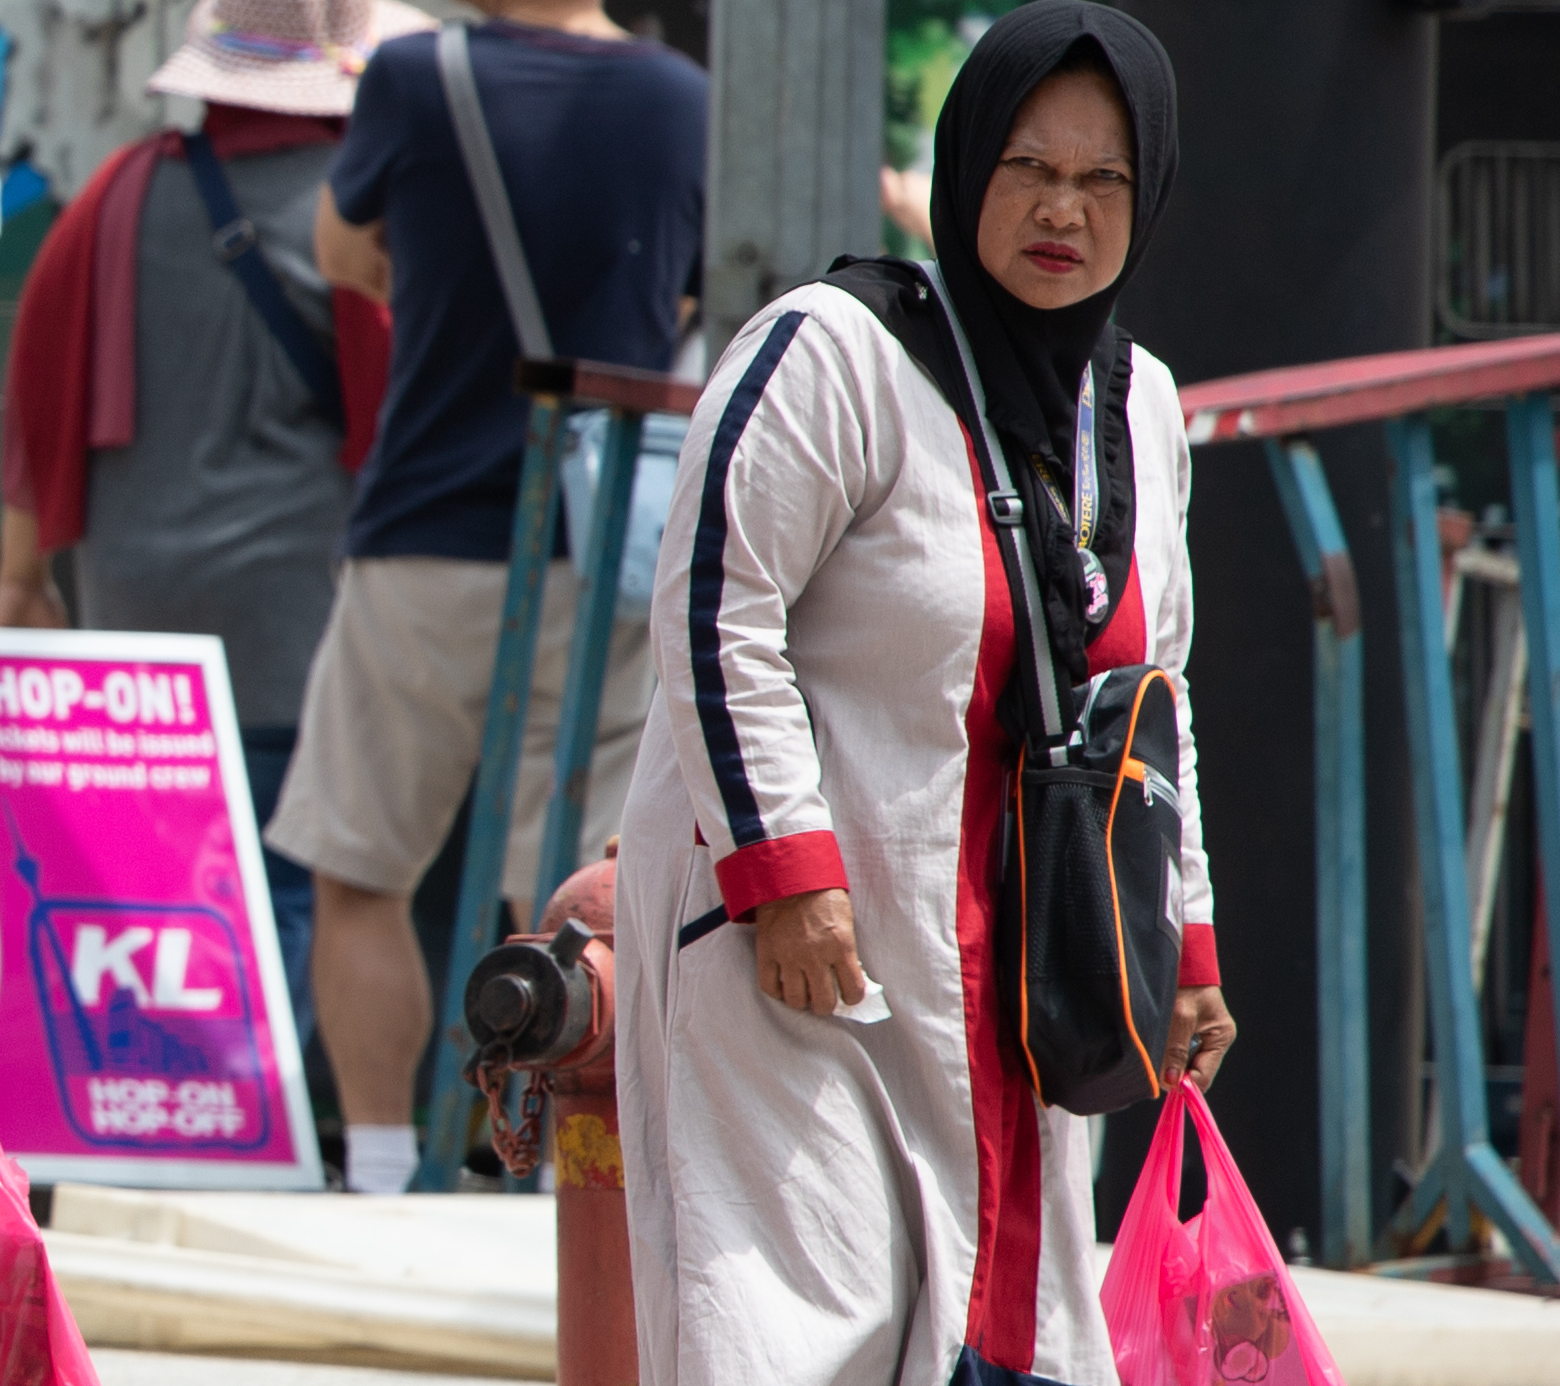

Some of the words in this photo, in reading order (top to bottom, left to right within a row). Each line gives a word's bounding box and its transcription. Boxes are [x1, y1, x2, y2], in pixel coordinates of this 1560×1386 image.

[62, 726, 104, 755] will
[105, 727, 135, 757] be
[138, 729, 216, 758] issued
[26, 762, 63, 787] our
[66, 761, 147, 792] ground
[149, 766, 211, 790] crew
[73, 924, 222, 1010] KL
[88, 1076, 235, 1106] HOP-ON
[91, 1106, 246, 1138] HOP-OFF
